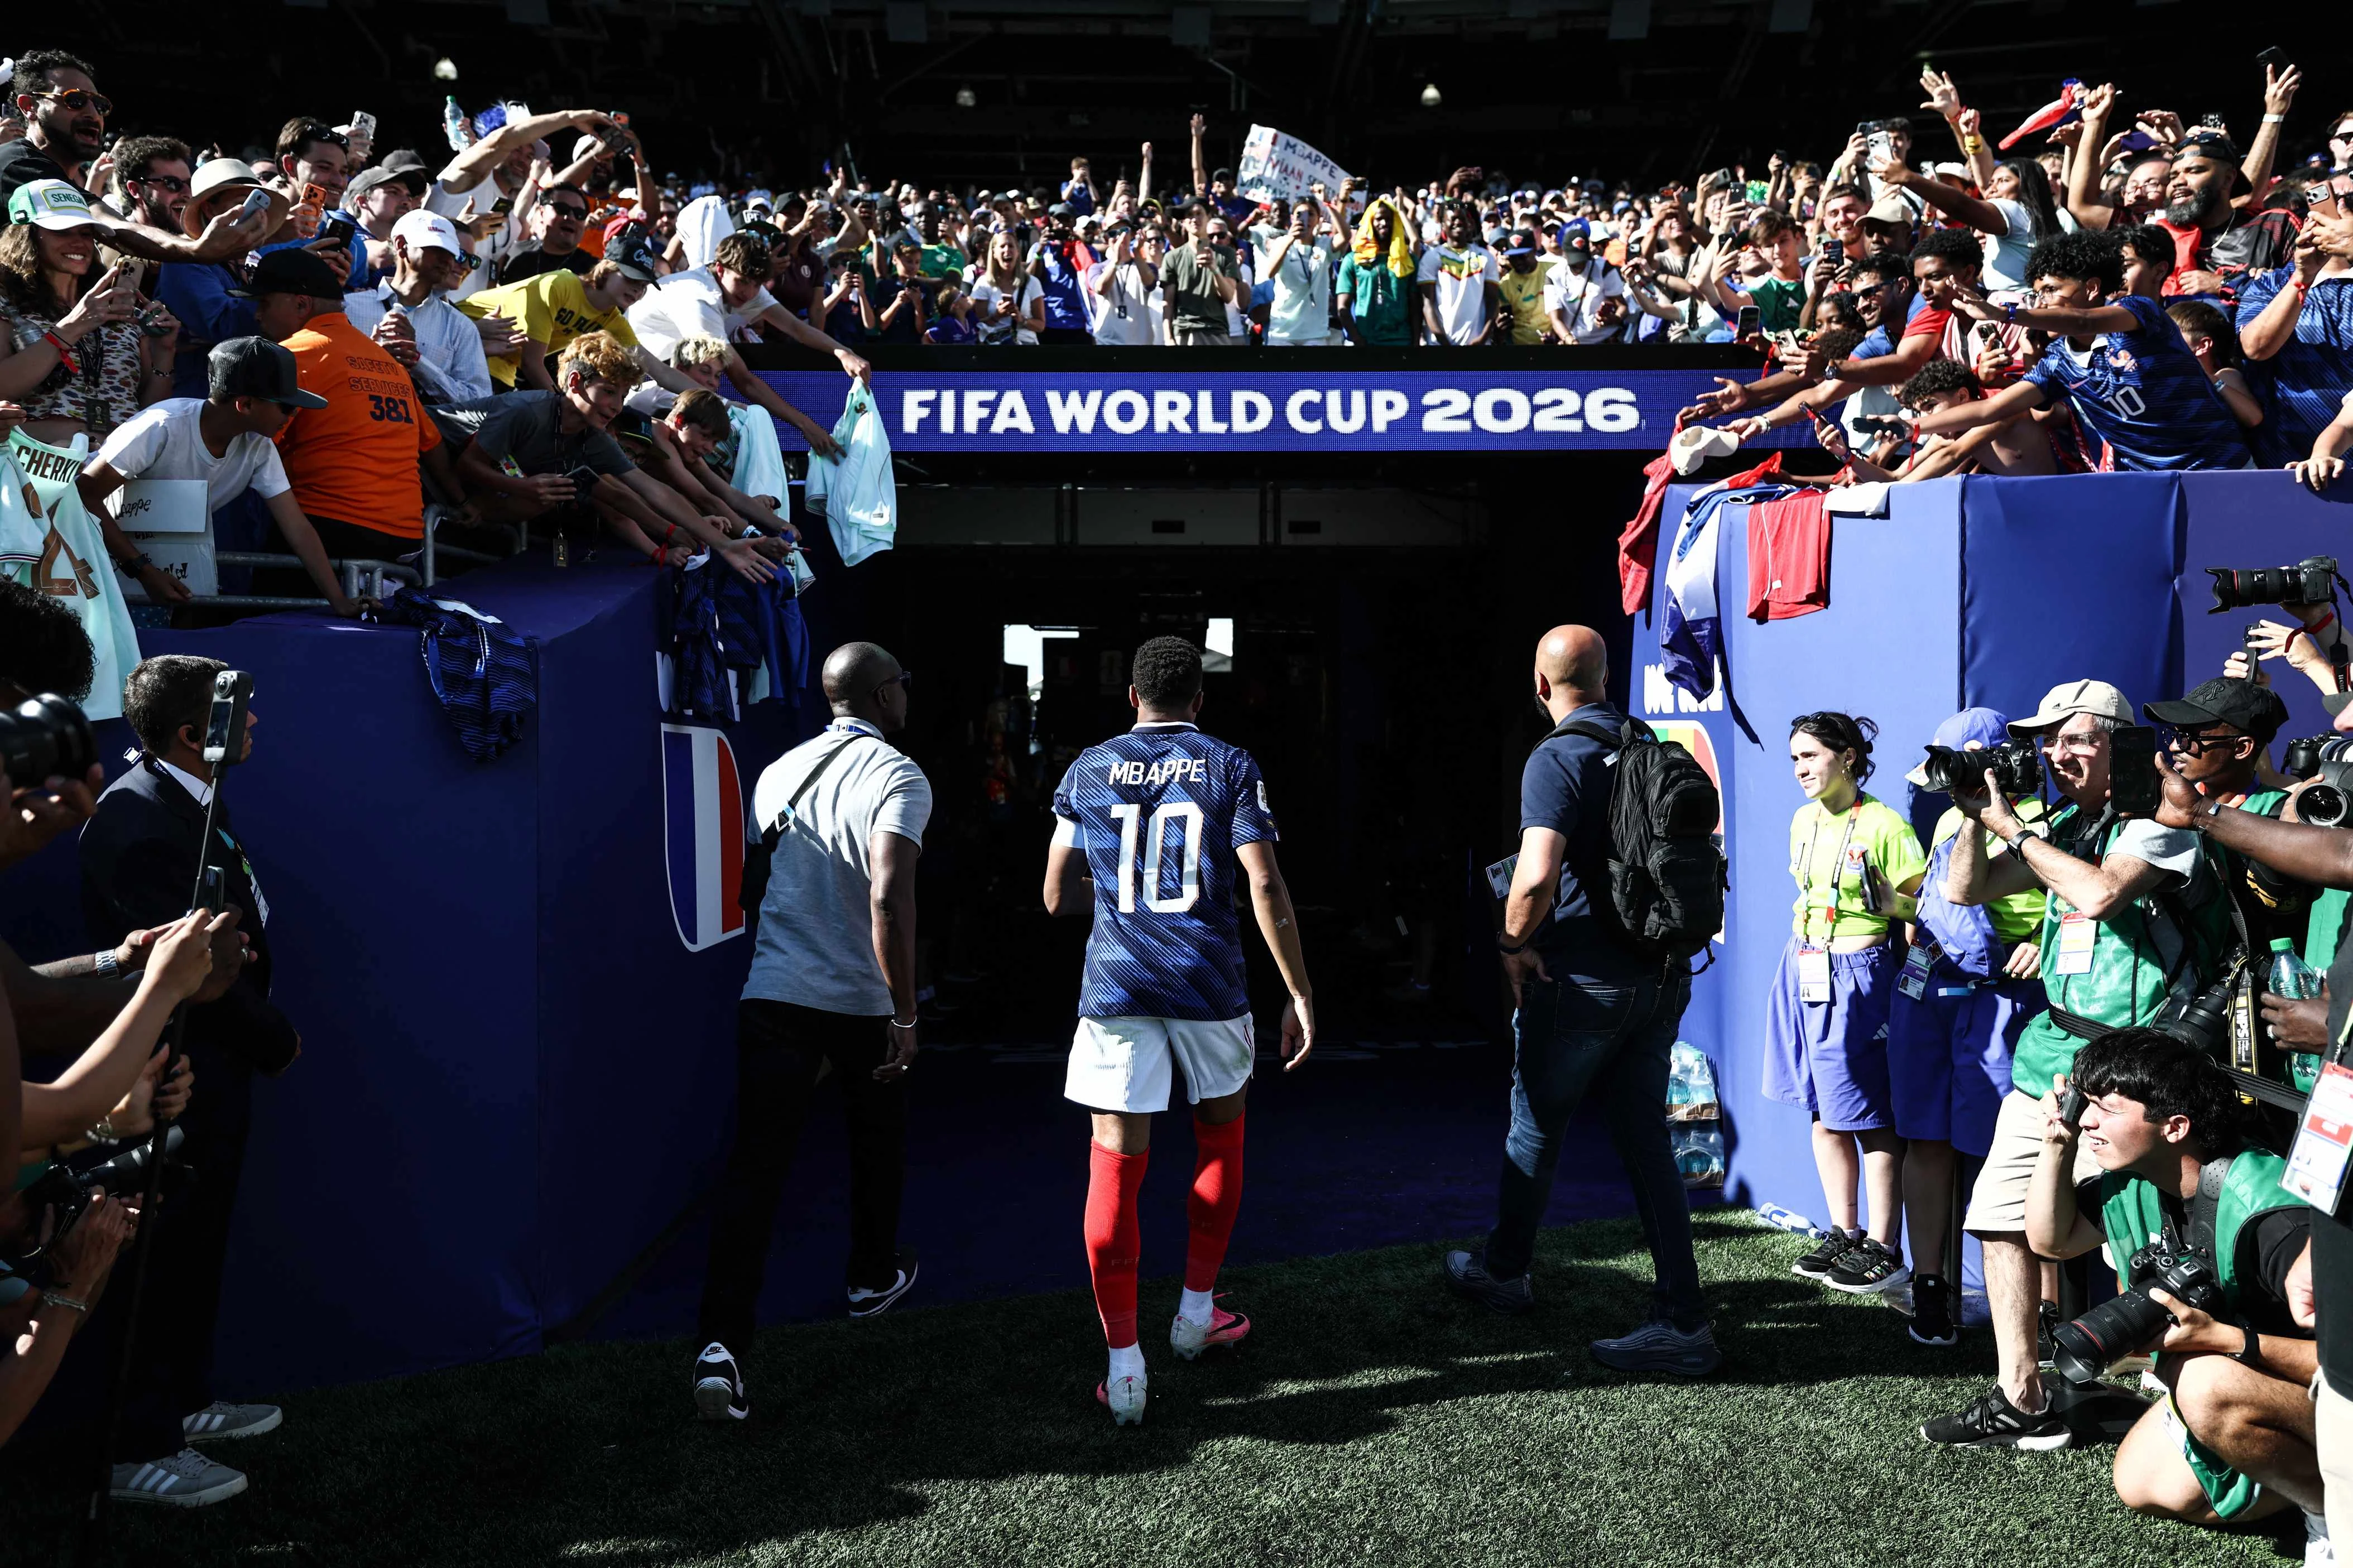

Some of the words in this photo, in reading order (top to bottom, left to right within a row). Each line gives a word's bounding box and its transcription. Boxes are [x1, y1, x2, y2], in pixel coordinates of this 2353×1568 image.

[346, 356, 399, 375] SAFETY
[348, 376, 412, 398] SERVICES
[368, 394, 414, 424] 381
[901, 389, 1036, 434] FIFA
[1044, 388, 1274, 435] WORLD
[1285, 389, 1409, 434] CUP
[1420, 387, 1640, 433] 2026
[2103, 385, 2146, 422] 10
[1108, 759, 1206, 786] MBAPPE
[1110, 801, 1204, 913] 10
[2237, 1009, 2249, 1038] NPS
